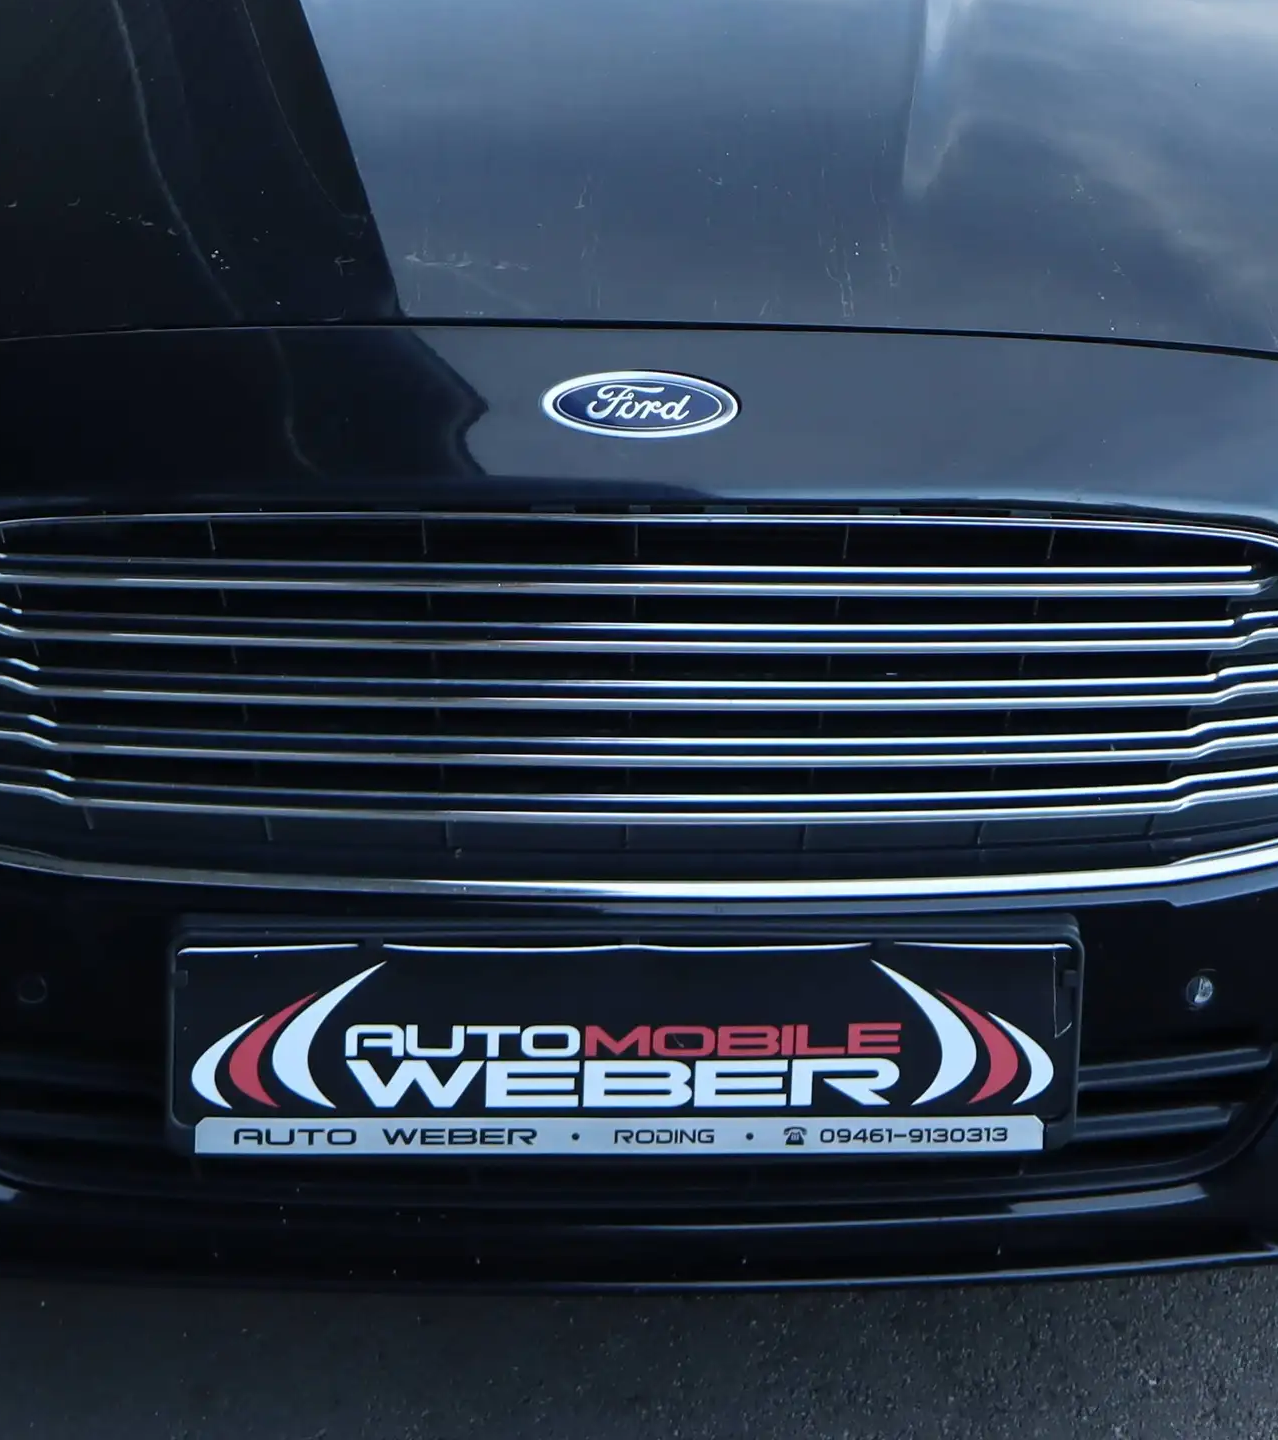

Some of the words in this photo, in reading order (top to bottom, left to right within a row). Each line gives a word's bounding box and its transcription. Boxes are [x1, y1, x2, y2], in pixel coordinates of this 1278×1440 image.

[586, 384, 691, 421] Ford
[344, 1022, 902, 1058] AUTOMOBILE
[345, 1058, 901, 1109] WEBER
[233, 1128, 358, 1146] AUTO
[381, 1127, 539, 1146] WEBER
[613, 1128, 716, 1145] RODING
[819, 1126, 1009, 1144] 09461-9130313
